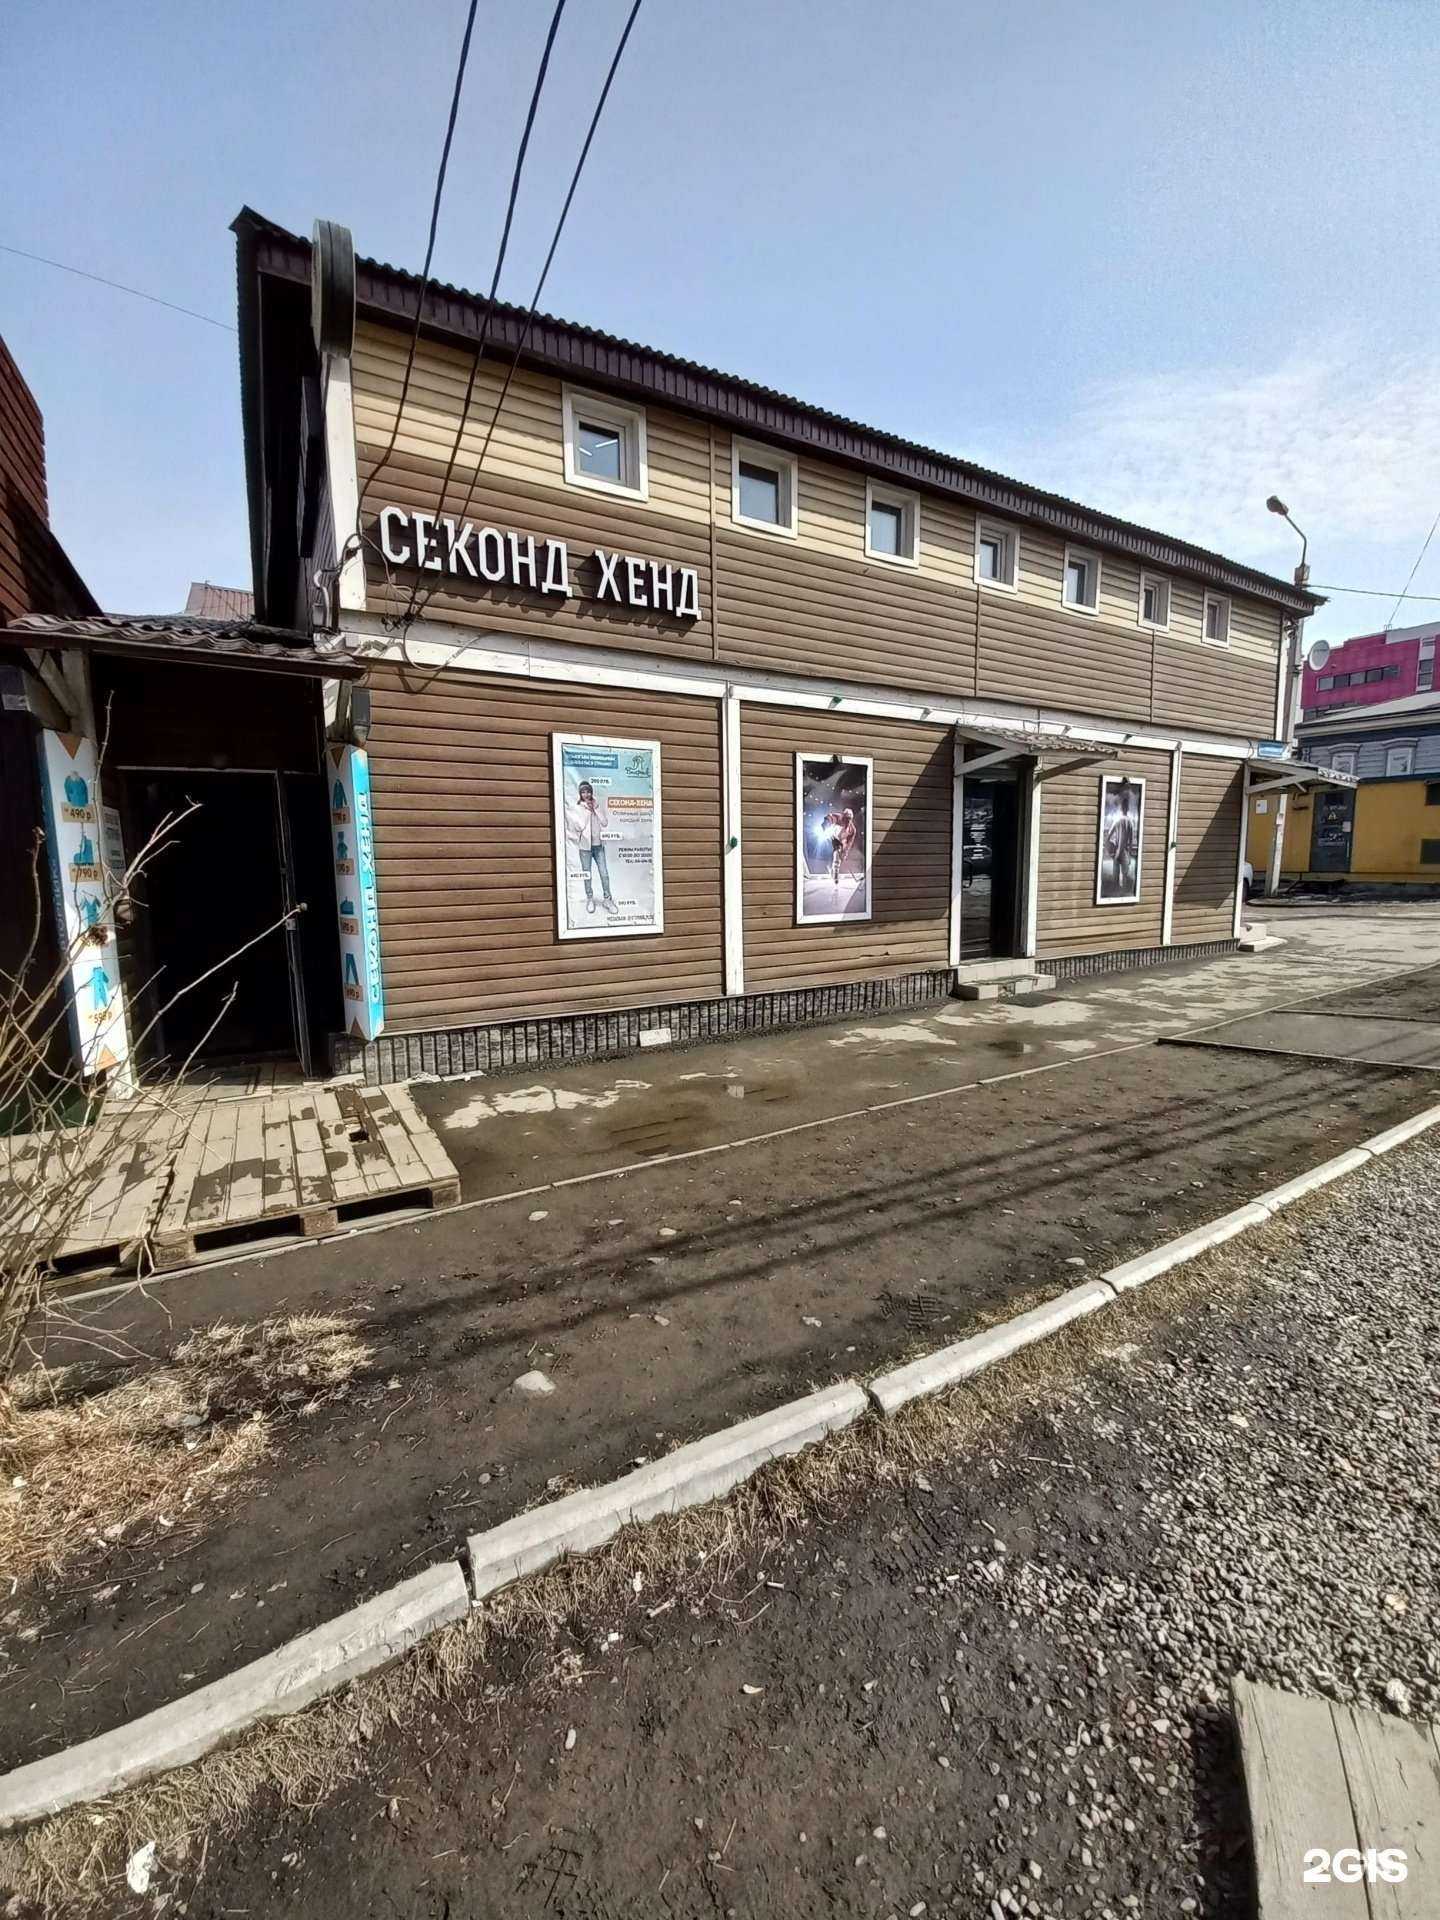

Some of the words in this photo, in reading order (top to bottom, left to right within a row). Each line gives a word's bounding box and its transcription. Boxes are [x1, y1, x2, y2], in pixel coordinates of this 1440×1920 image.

[379, 505, 573, 598] СЕКОНД
[594, 549, 702, 620] ХЕНД
[70, 808, 85, 819] 490
